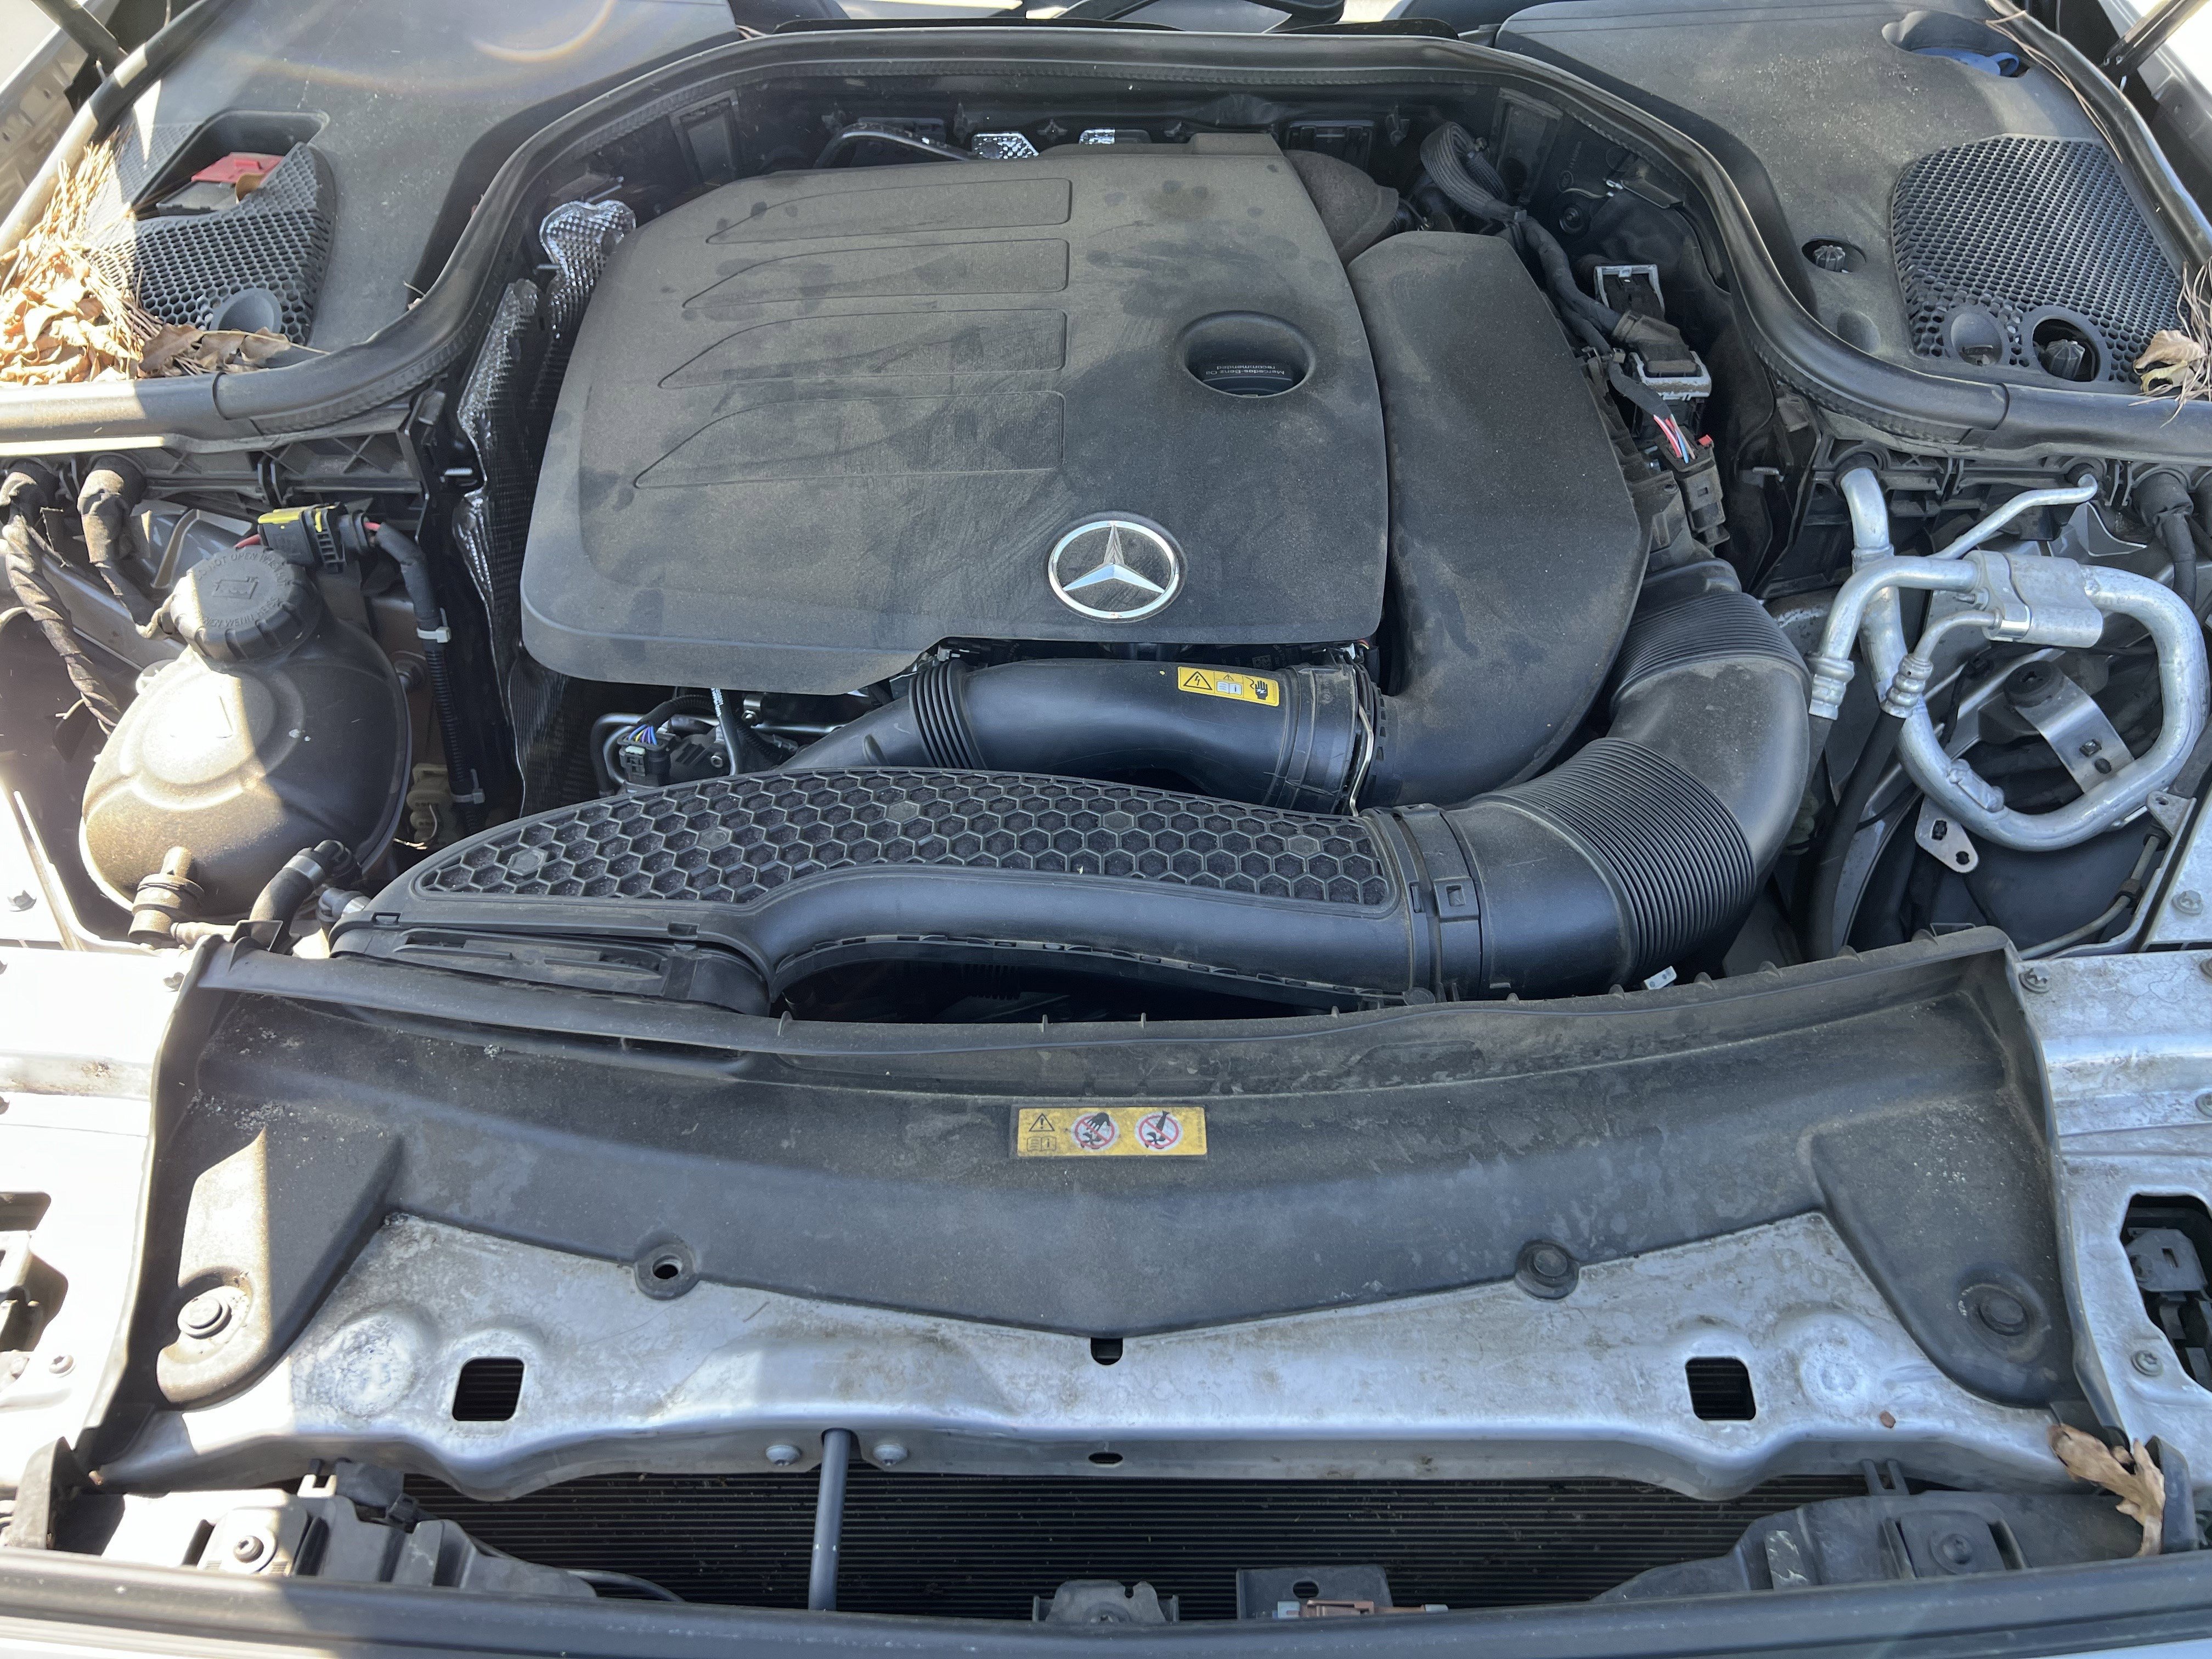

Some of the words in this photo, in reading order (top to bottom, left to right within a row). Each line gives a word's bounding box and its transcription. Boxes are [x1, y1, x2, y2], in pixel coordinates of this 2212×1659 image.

[208, 556, 227, 571] NOT
[231, 552, 258, 561] OPEN
[259, 554, 281, 572] WHEN
[225, 613, 254, 628] WENN
